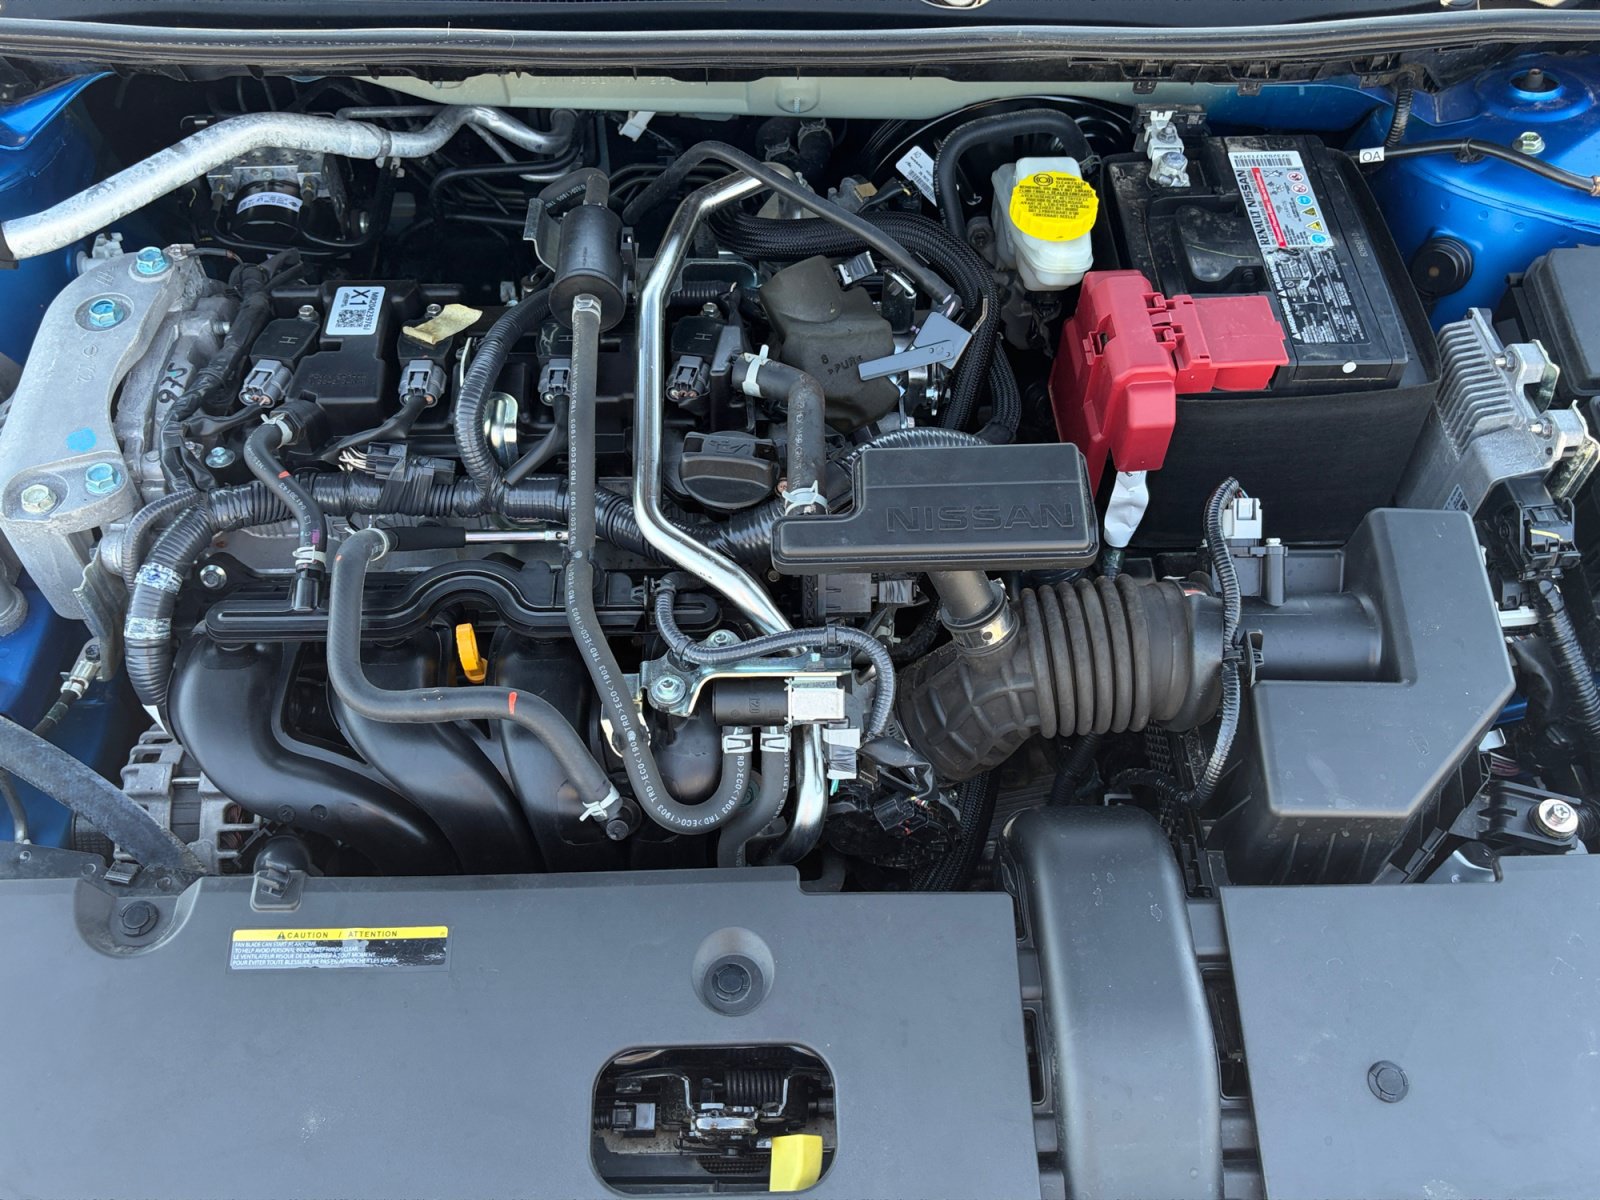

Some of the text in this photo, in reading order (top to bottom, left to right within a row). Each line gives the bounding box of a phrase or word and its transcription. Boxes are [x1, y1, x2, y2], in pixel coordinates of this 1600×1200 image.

[1236, 169, 1258, 208] NISSAN
[1250, 210, 1271, 246] RENAULT
[349, 289, 371, 305] X1
[887, 503, 1075, 532] NISSAN
[599, 664, 632, 732] TRD>ECO<1903
[721, 755, 745, 816] RD>ECO<1903
[656, 804, 721, 827] TRD>ECO<1903
[287, 931, 329, 939] CAUTION
[348, 930, 398, 938] ATTENTION
